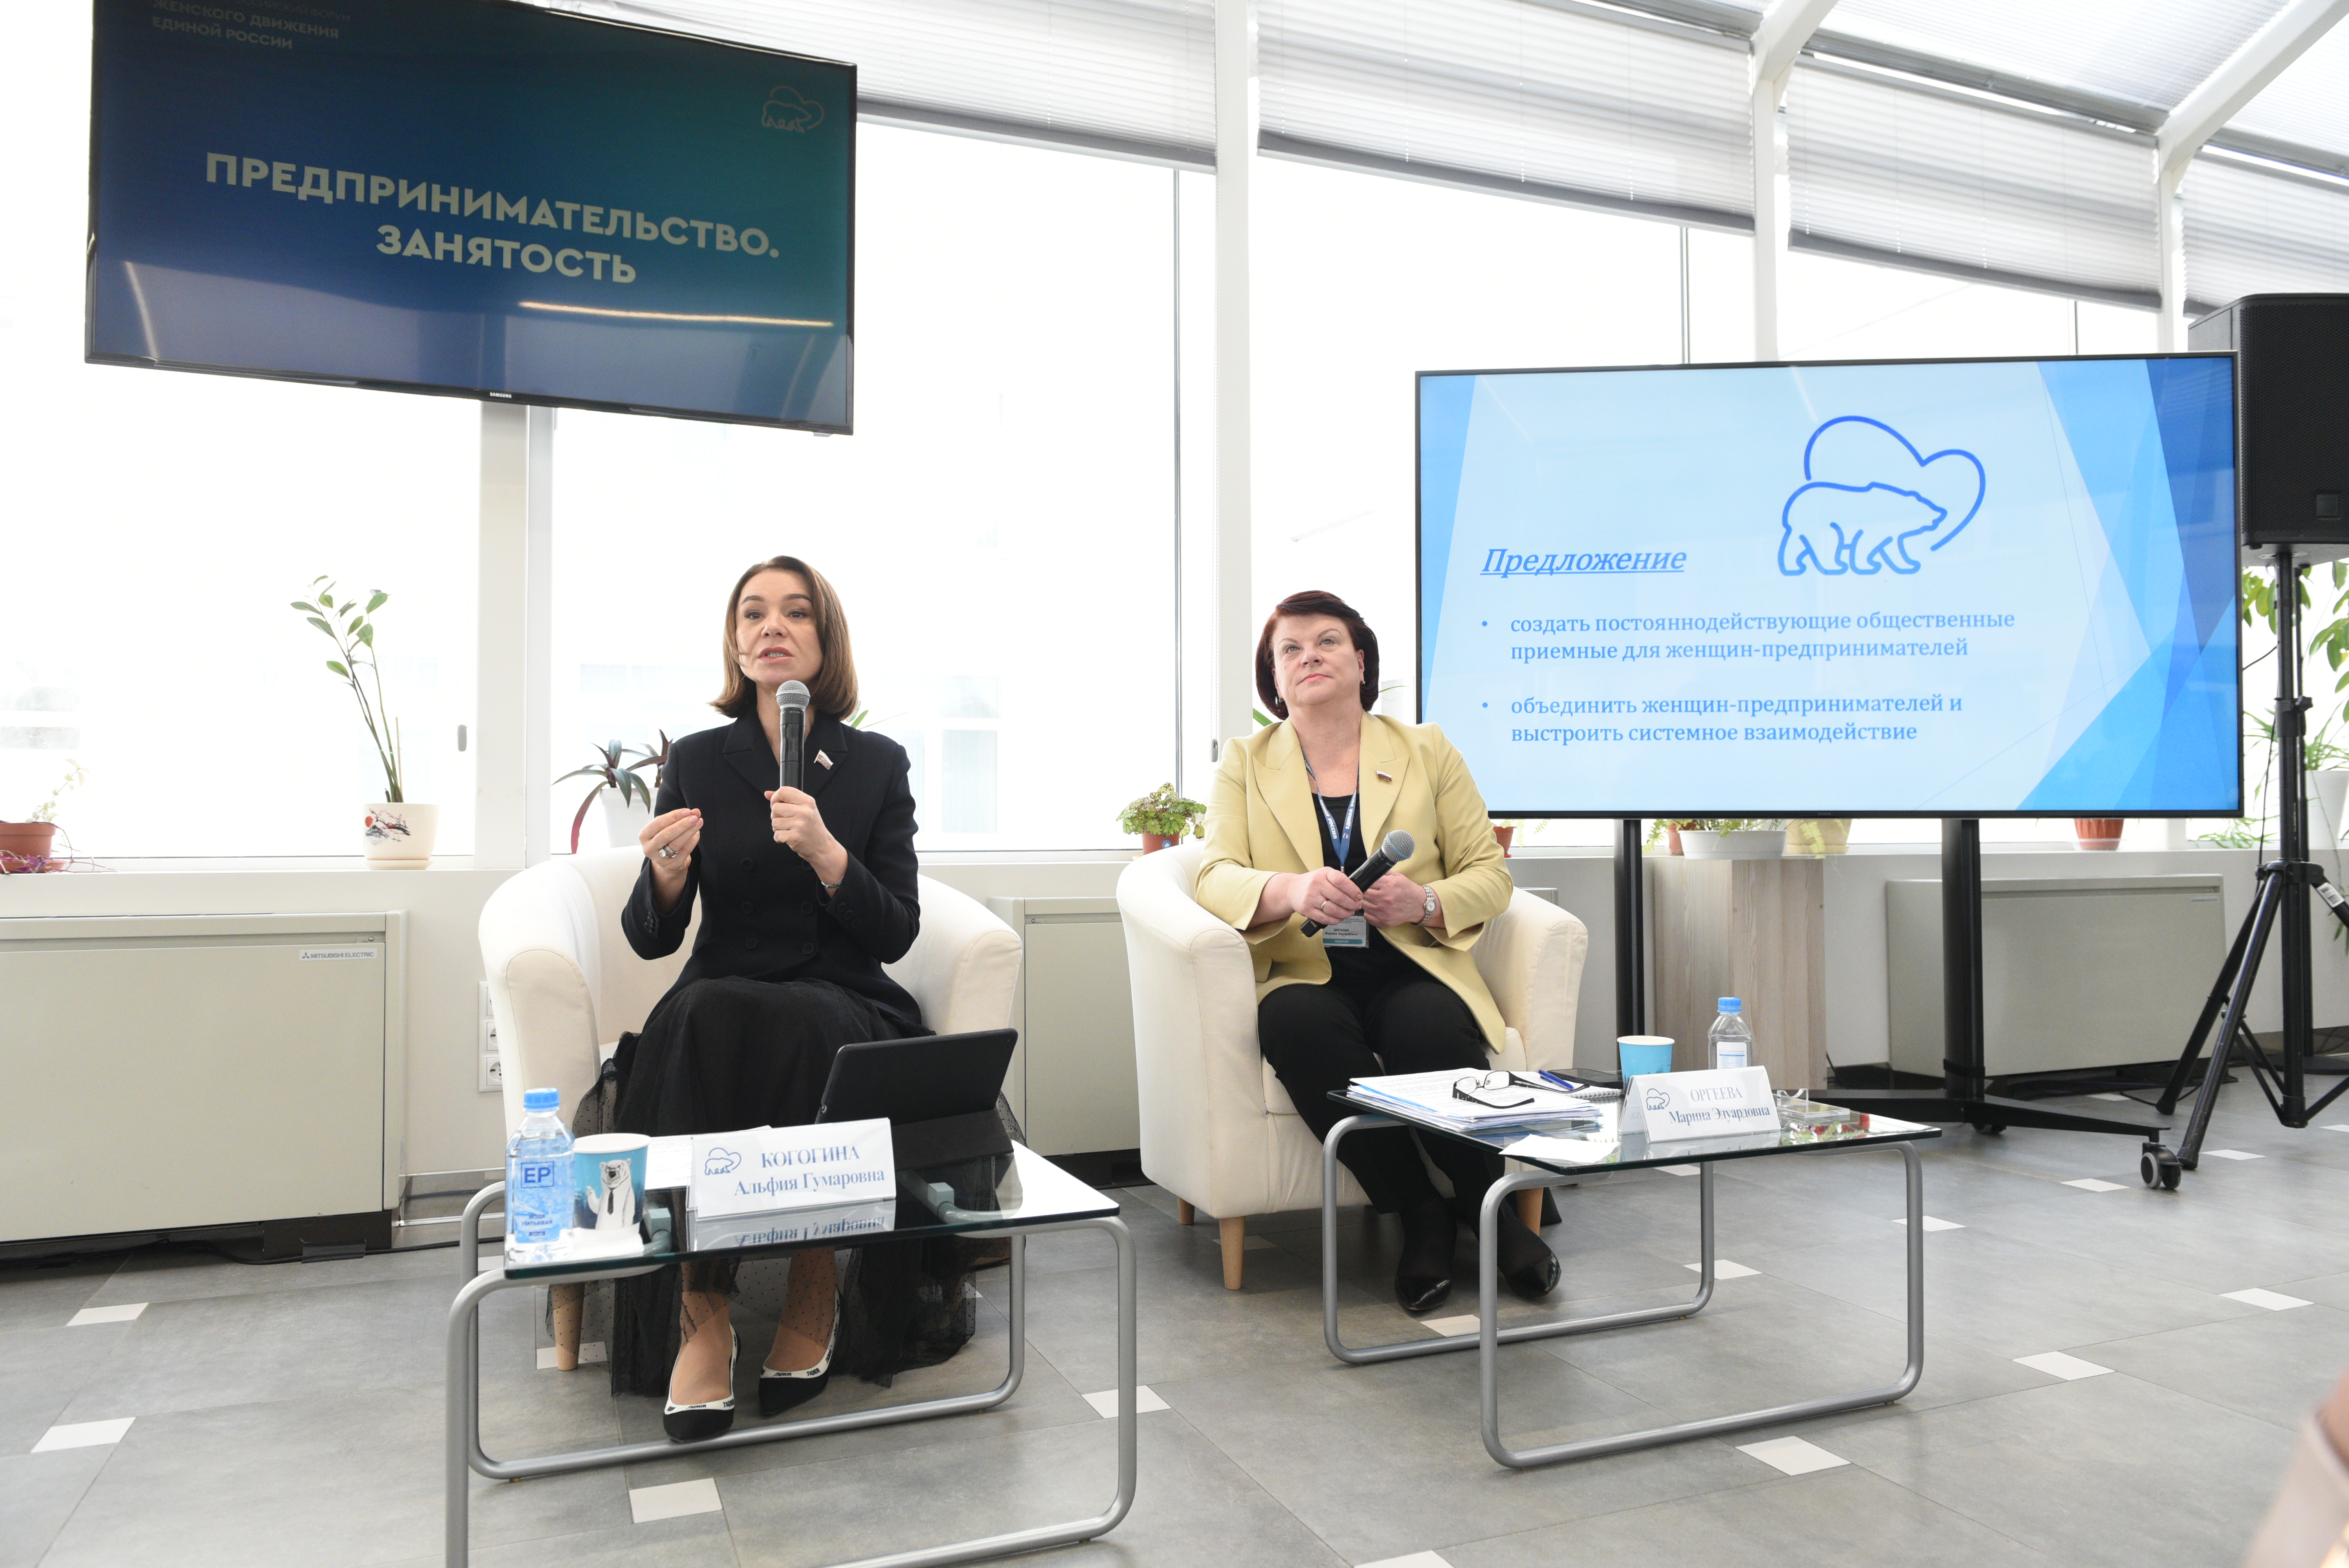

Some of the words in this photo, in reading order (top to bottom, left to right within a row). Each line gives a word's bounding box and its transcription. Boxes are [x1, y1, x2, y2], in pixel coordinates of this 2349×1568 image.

[152, 0, 246, 23] ЖЕНСКОГО
[249, 14, 339, 39] ДВИЖЕНИЯ
[151, 16, 221, 37] ЕДИНОЙ
[226, 29, 293, 50] РОССИИ
[206, 152, 779, 258] ПРЕДПРИНИМАТЕЛЬСТВО.
[376, 225, 636, 283] ЗАНЯТОСТЬ
[1481, 549, 1687, 578] Предложение
[1511, 618, 1590, 635] создать
[1595, 613, 1851, 634] постояннодействующие
[1857, 611, 2015, 631] общественные
[1511, 645, 1617, 664] приемные
[1622, 645, 1660, 661] для
[1666, 638, 1968, 661] женщин-предпринимателей
[1511, 697, 1637, 716] объединить
[1642, 694, 1943, 717] женщин-предпринимателей
[1949, 698, 1962, 711] и
[1511, 728, 1623, 745] выстроить
[1629, 727, 1738, 741] системное
[1744, 722, 1917, 743] взаимодействие
[1345, 808, 1353, 829] ЕДИНАЯ
[1690, 1086, 1743, 1102] ОРГЕЕВА
[1668, 1110, 1711, 1126] Марина
[1713, 1106, 1770, 1123] Эдуардовна
[761, 1145, 861, 1168] КОГОГИНА
[734, 1177, 798, 1196] Альфия
[803, 1170, 885, 1192] Гумаровна
